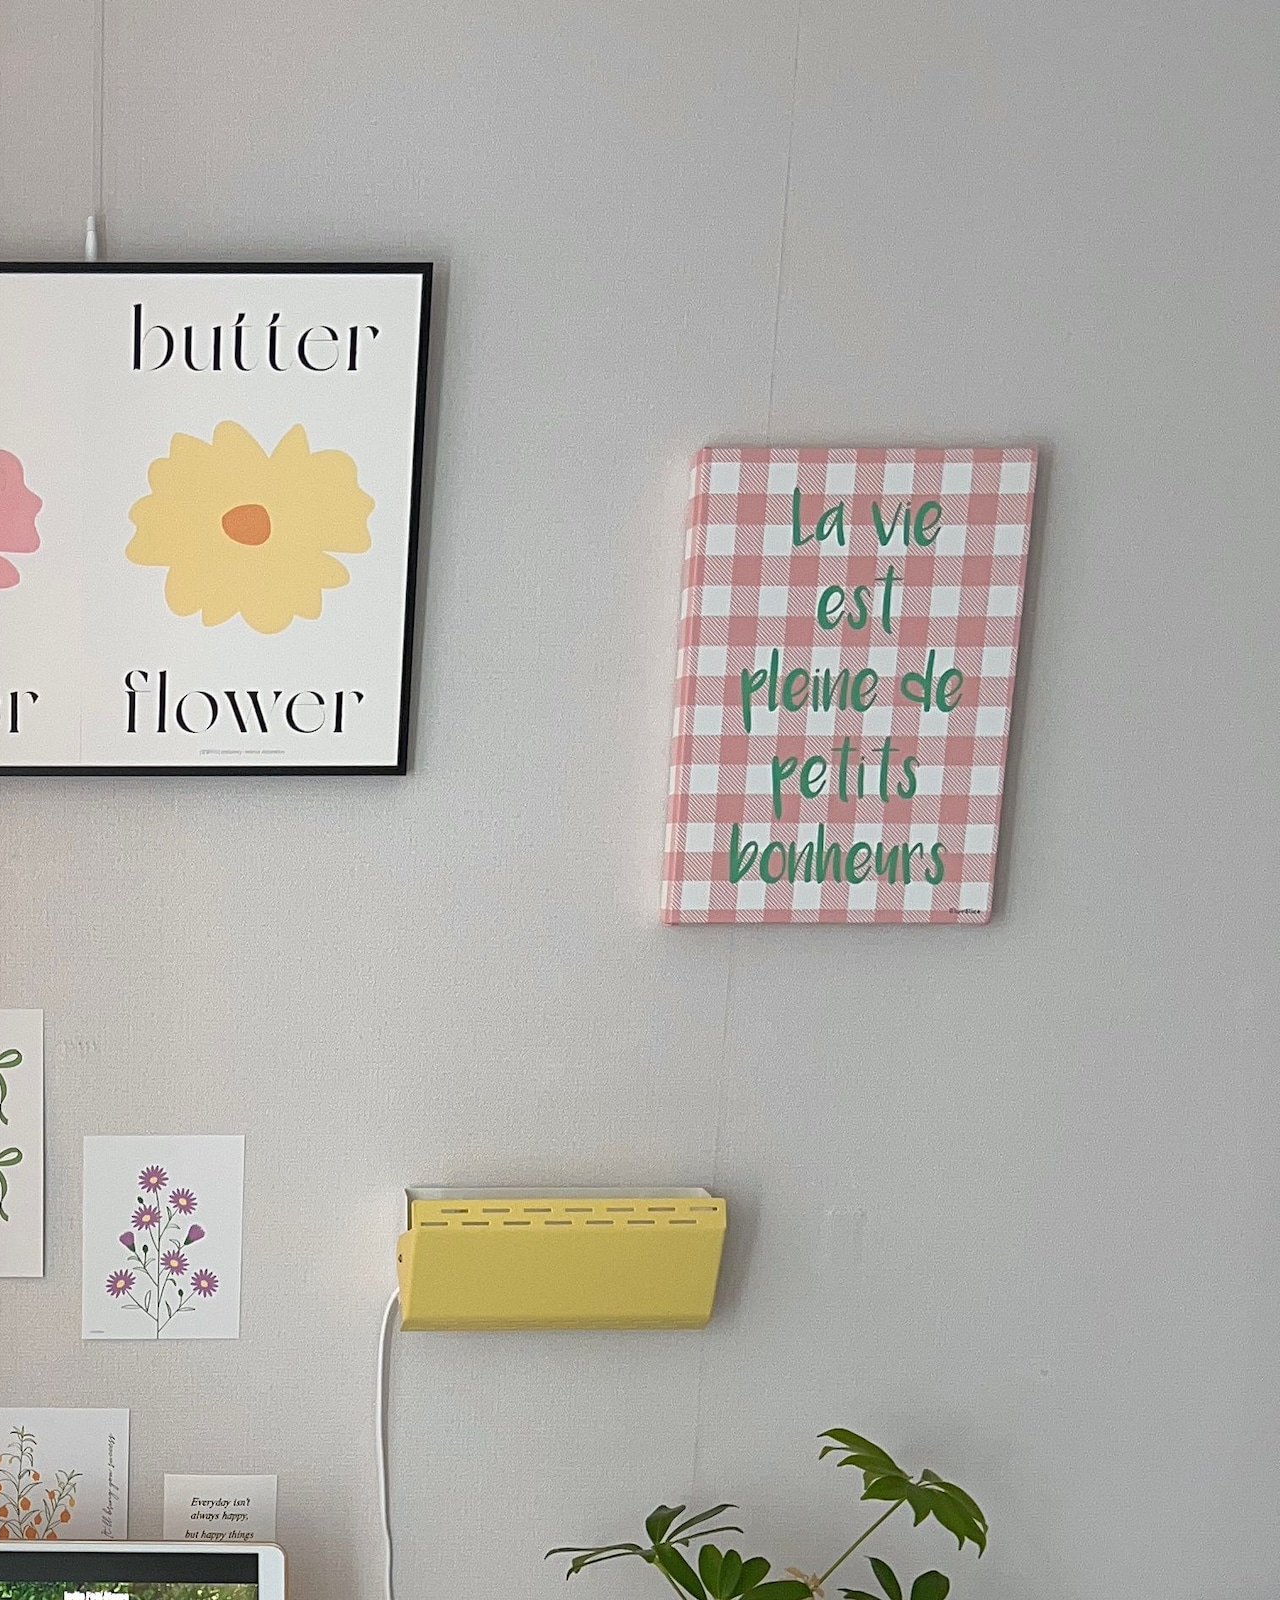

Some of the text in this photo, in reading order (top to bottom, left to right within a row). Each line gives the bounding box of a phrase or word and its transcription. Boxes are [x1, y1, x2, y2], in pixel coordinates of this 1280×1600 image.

[132, 303, 380, 372] butter
[792, 487, 943, 548] La vie
[816, 564, 904, 634] est
[124, 669, 365, 734] flower
[740, 647, 964, 734] pleine de
[771, 736, 920, 819] petits
[729, 822, 947, 886] bonheurs
[185, 1529, 254, 1541] but happy things
[190, 1511, 220, 1521] always
[191, 1497, 231, 1509] Everyday
